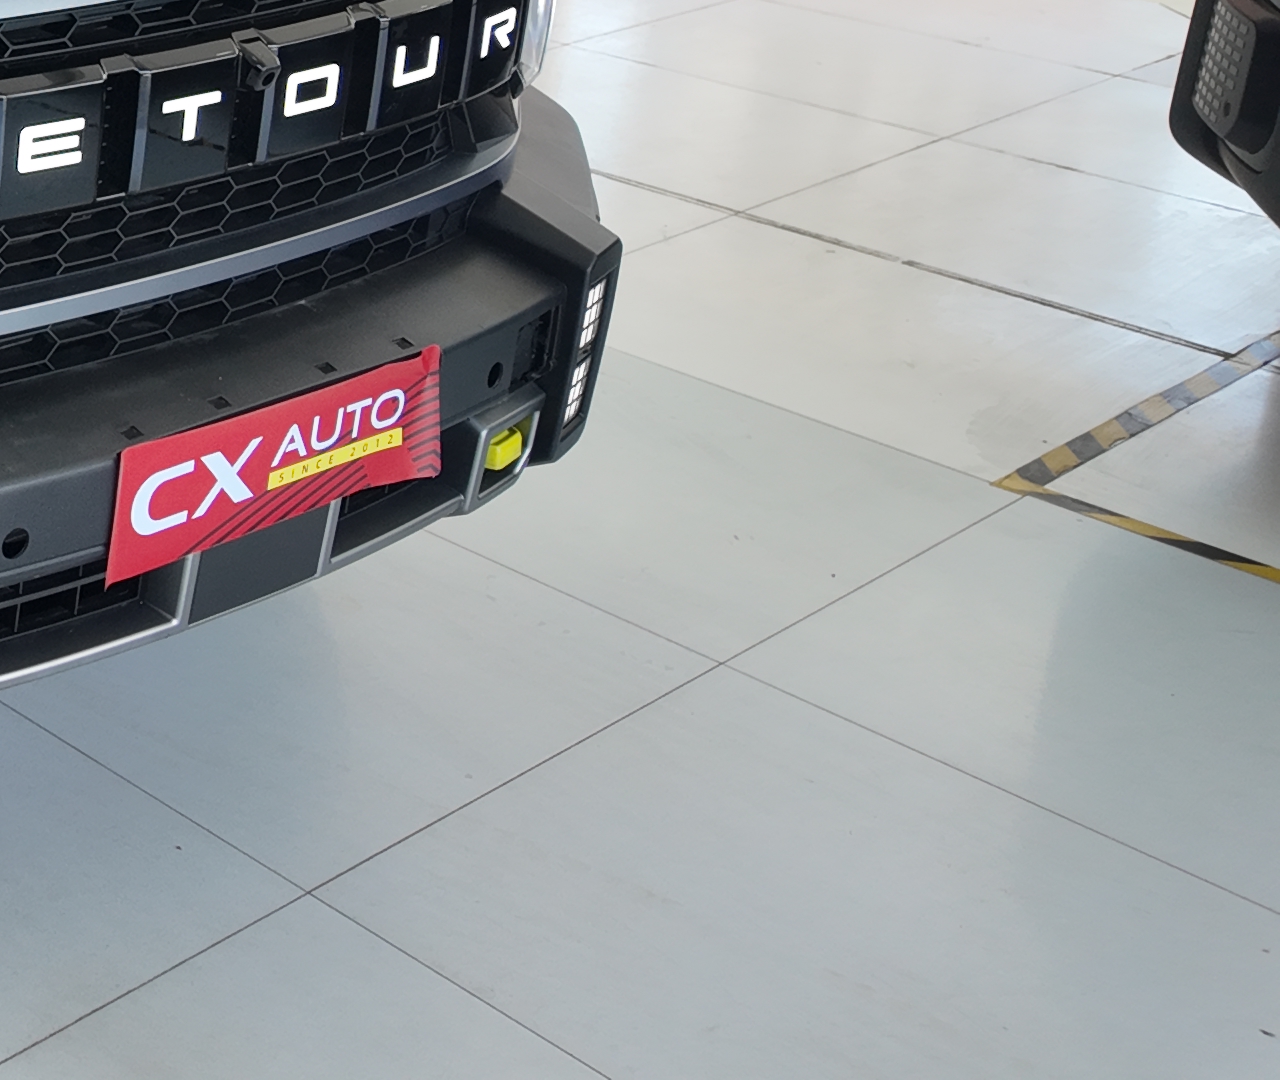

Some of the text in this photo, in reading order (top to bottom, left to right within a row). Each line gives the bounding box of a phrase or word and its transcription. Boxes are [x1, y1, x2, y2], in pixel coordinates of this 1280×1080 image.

[130, 388, 406, 537] CX AUTO
[278, 433, 397, 484] SINCE 2012
